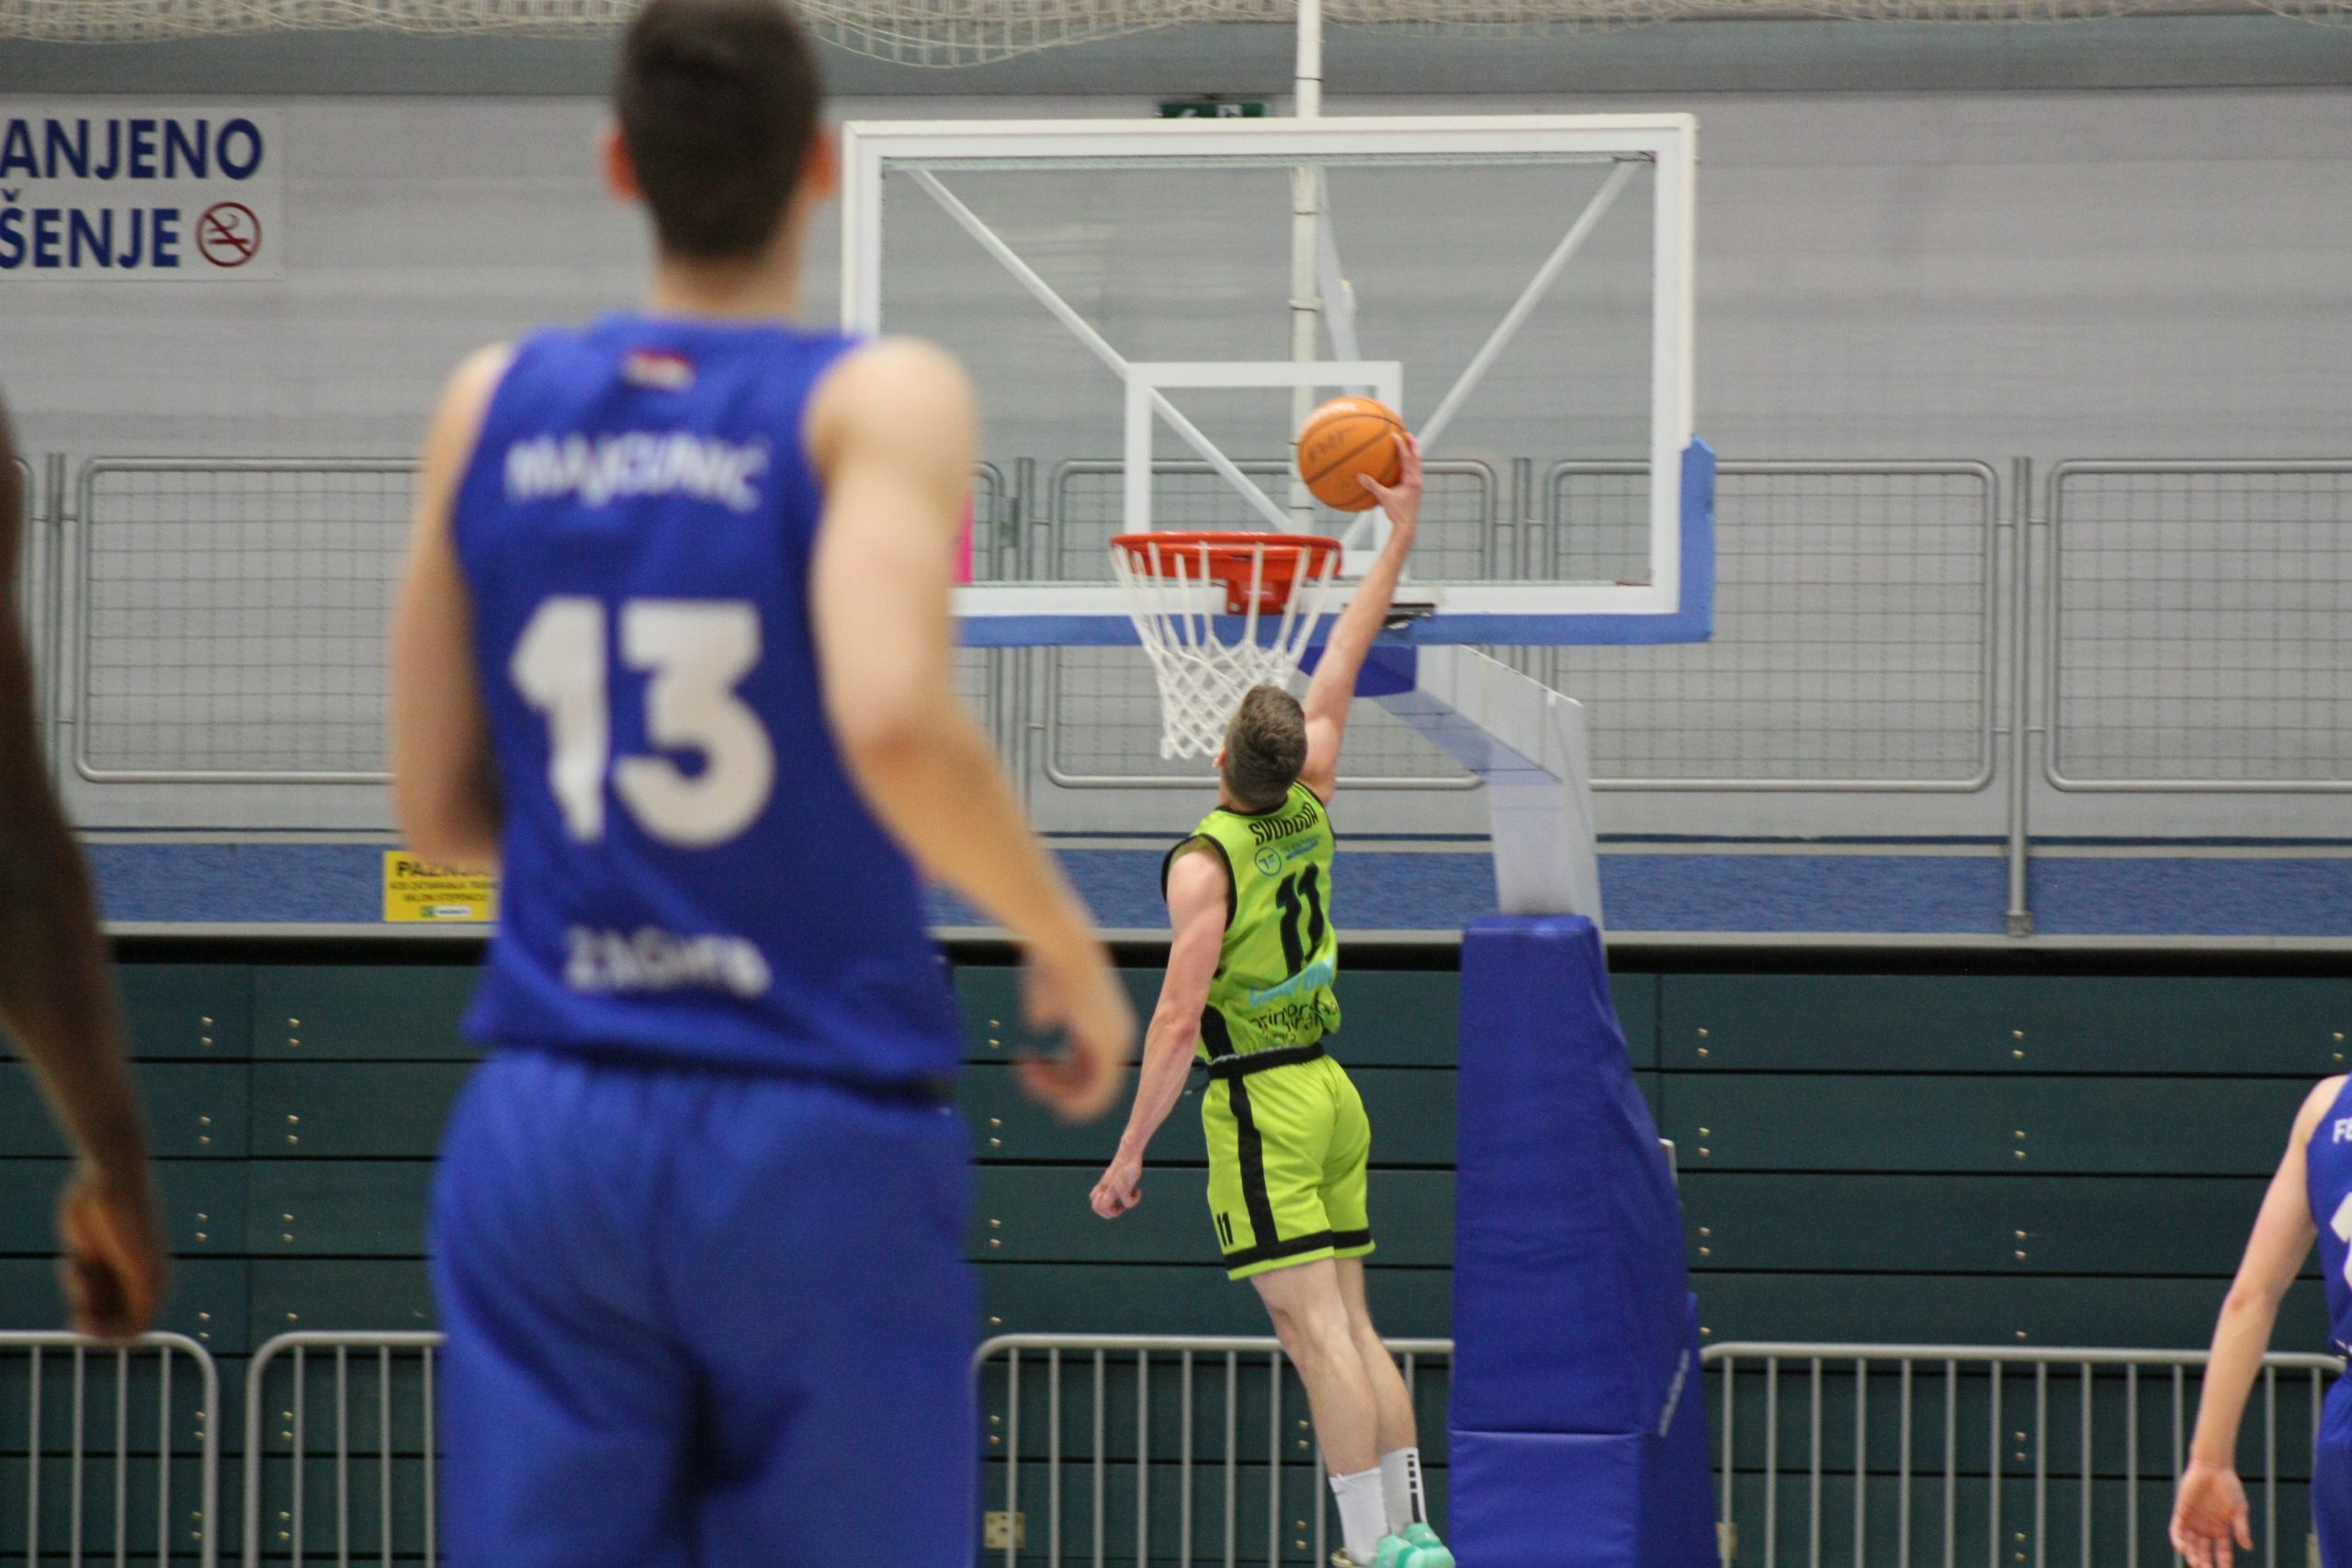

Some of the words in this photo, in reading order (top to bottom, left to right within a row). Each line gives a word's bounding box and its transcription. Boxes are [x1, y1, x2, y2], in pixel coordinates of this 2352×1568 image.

[1, 118, 264, 181] ANJENO
[0, 187, 182, 270] ŠENJE
[508, 593, 777, 849] 13
[1248, 801, 1319, 846] SVOBODA
[1275, 861, 1325, 978] 11
[1216, 1211, 1235, 1247] 11
